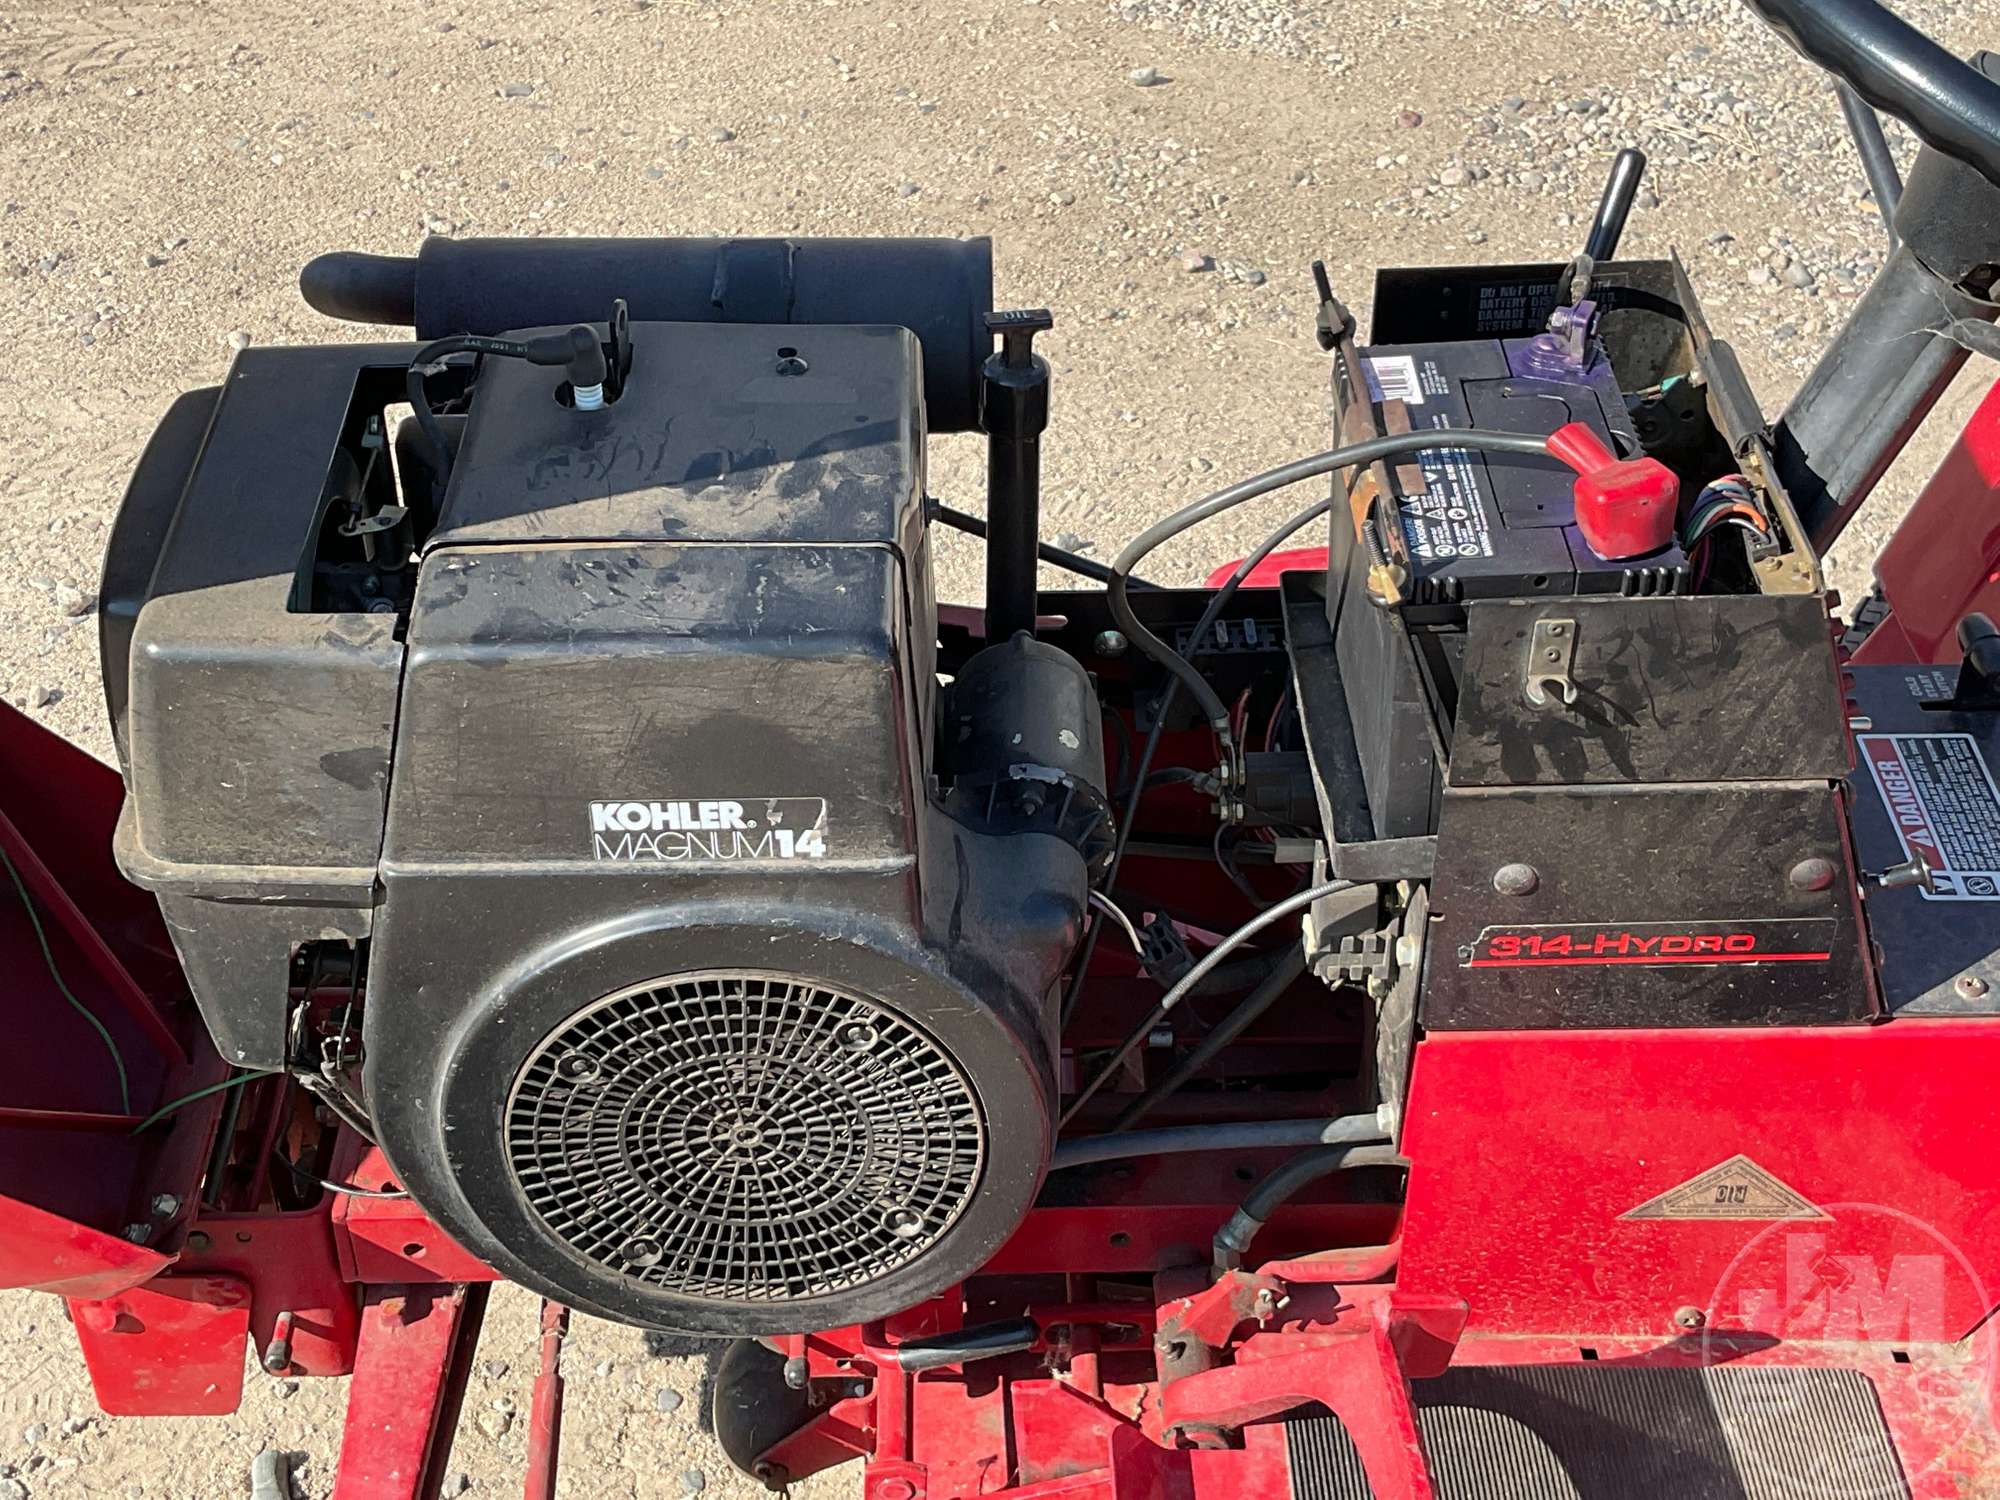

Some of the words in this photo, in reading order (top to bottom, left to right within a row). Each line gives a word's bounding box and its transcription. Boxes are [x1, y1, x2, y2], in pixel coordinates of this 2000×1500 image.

[1500, 285, 1524, 297] NOT
[1479, 296, 1527, 309] BATTERY
[1003, 311, 1031, 320] OIL
[1478, 308, 1525, 321] DAMAGE
[1876, 760, 1925, 826] DANGER
[1488, 932, 1756, 958] 314-HYDRO
